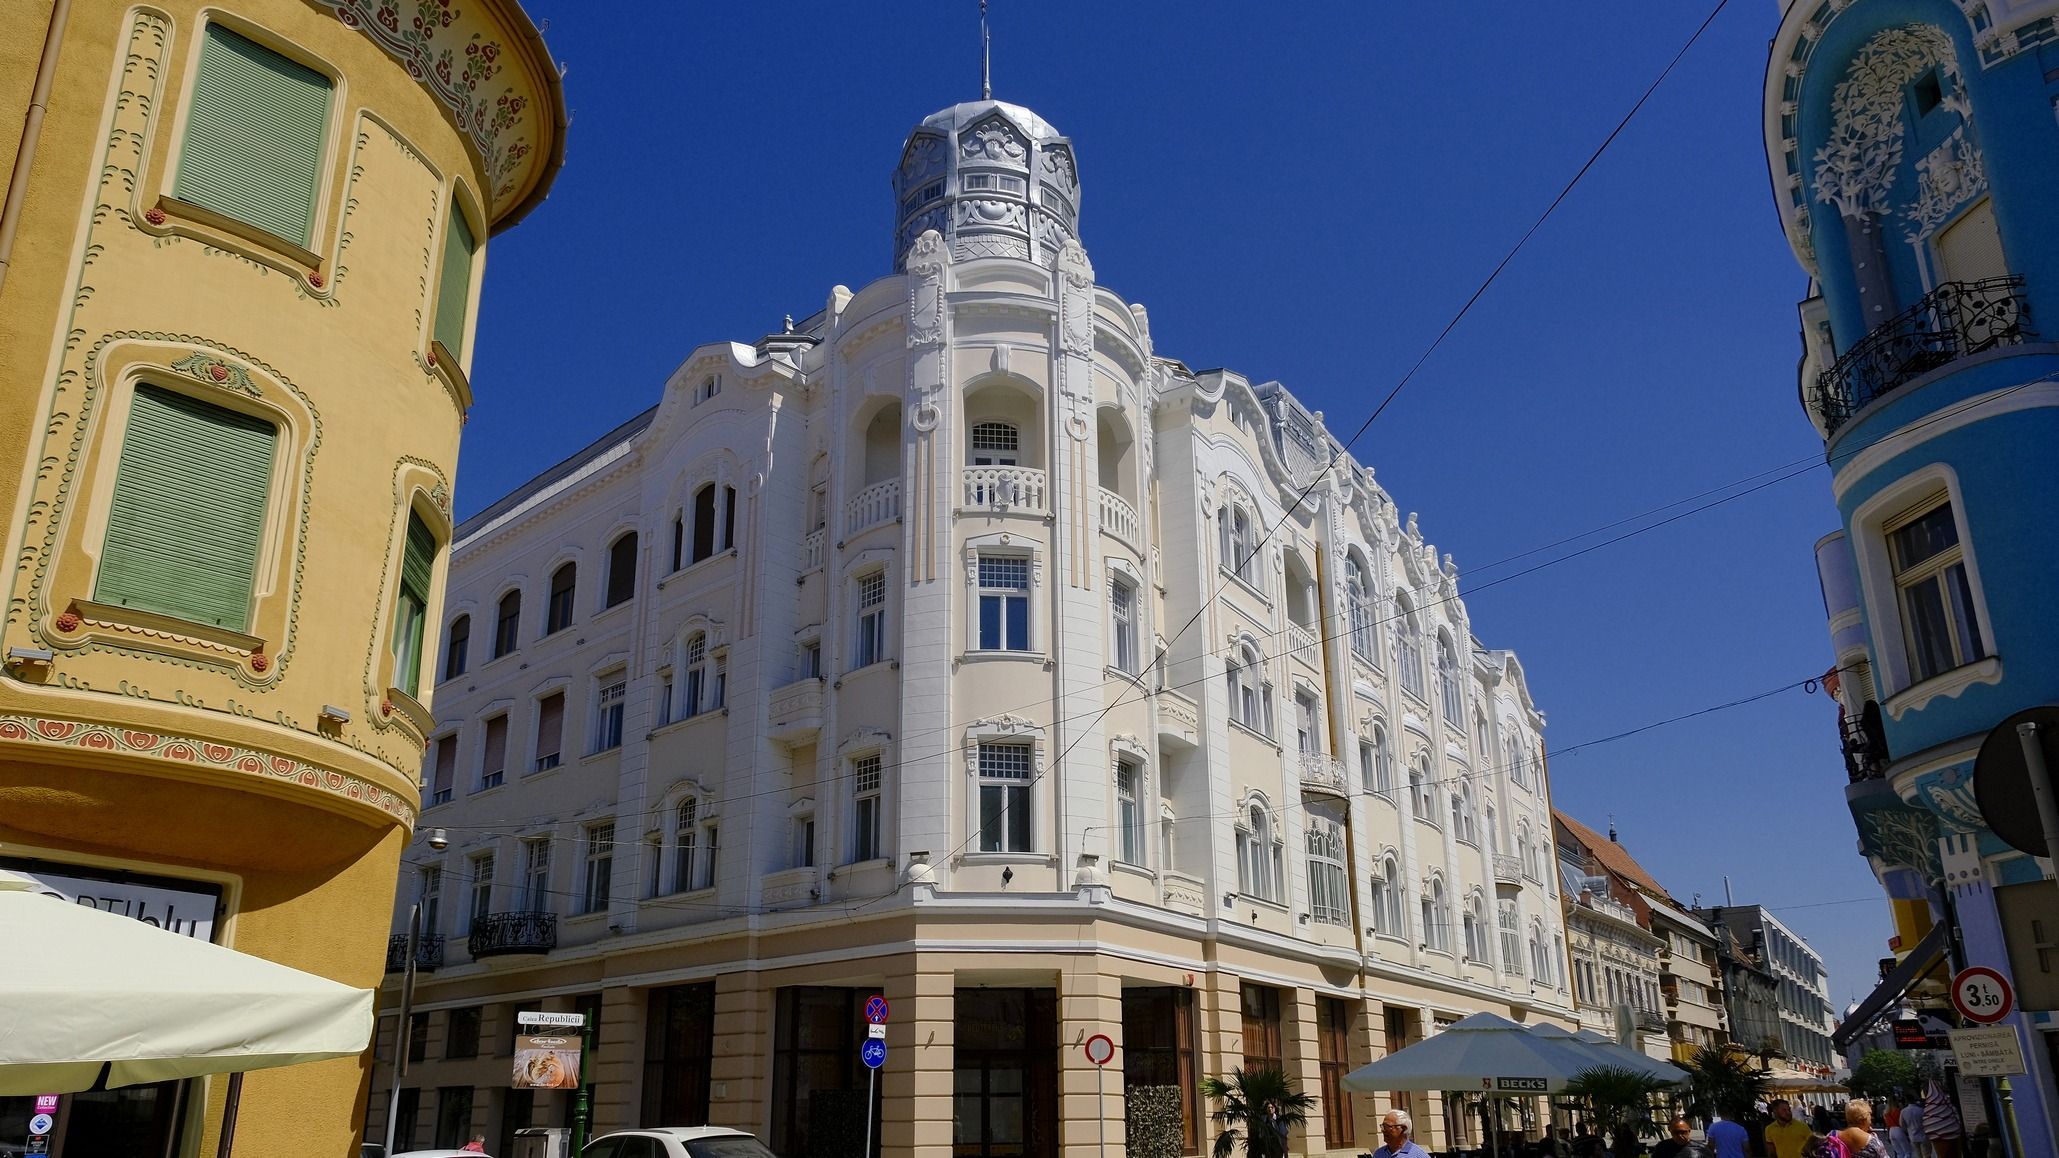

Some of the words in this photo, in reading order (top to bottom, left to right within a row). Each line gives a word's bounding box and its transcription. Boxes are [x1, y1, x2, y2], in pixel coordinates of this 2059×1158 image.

[538, 1014, 580, 1024] Republicii
[1500, 1079, 1546, 1089] BECK'S
[37, 1095, 57, 1106] NEW
